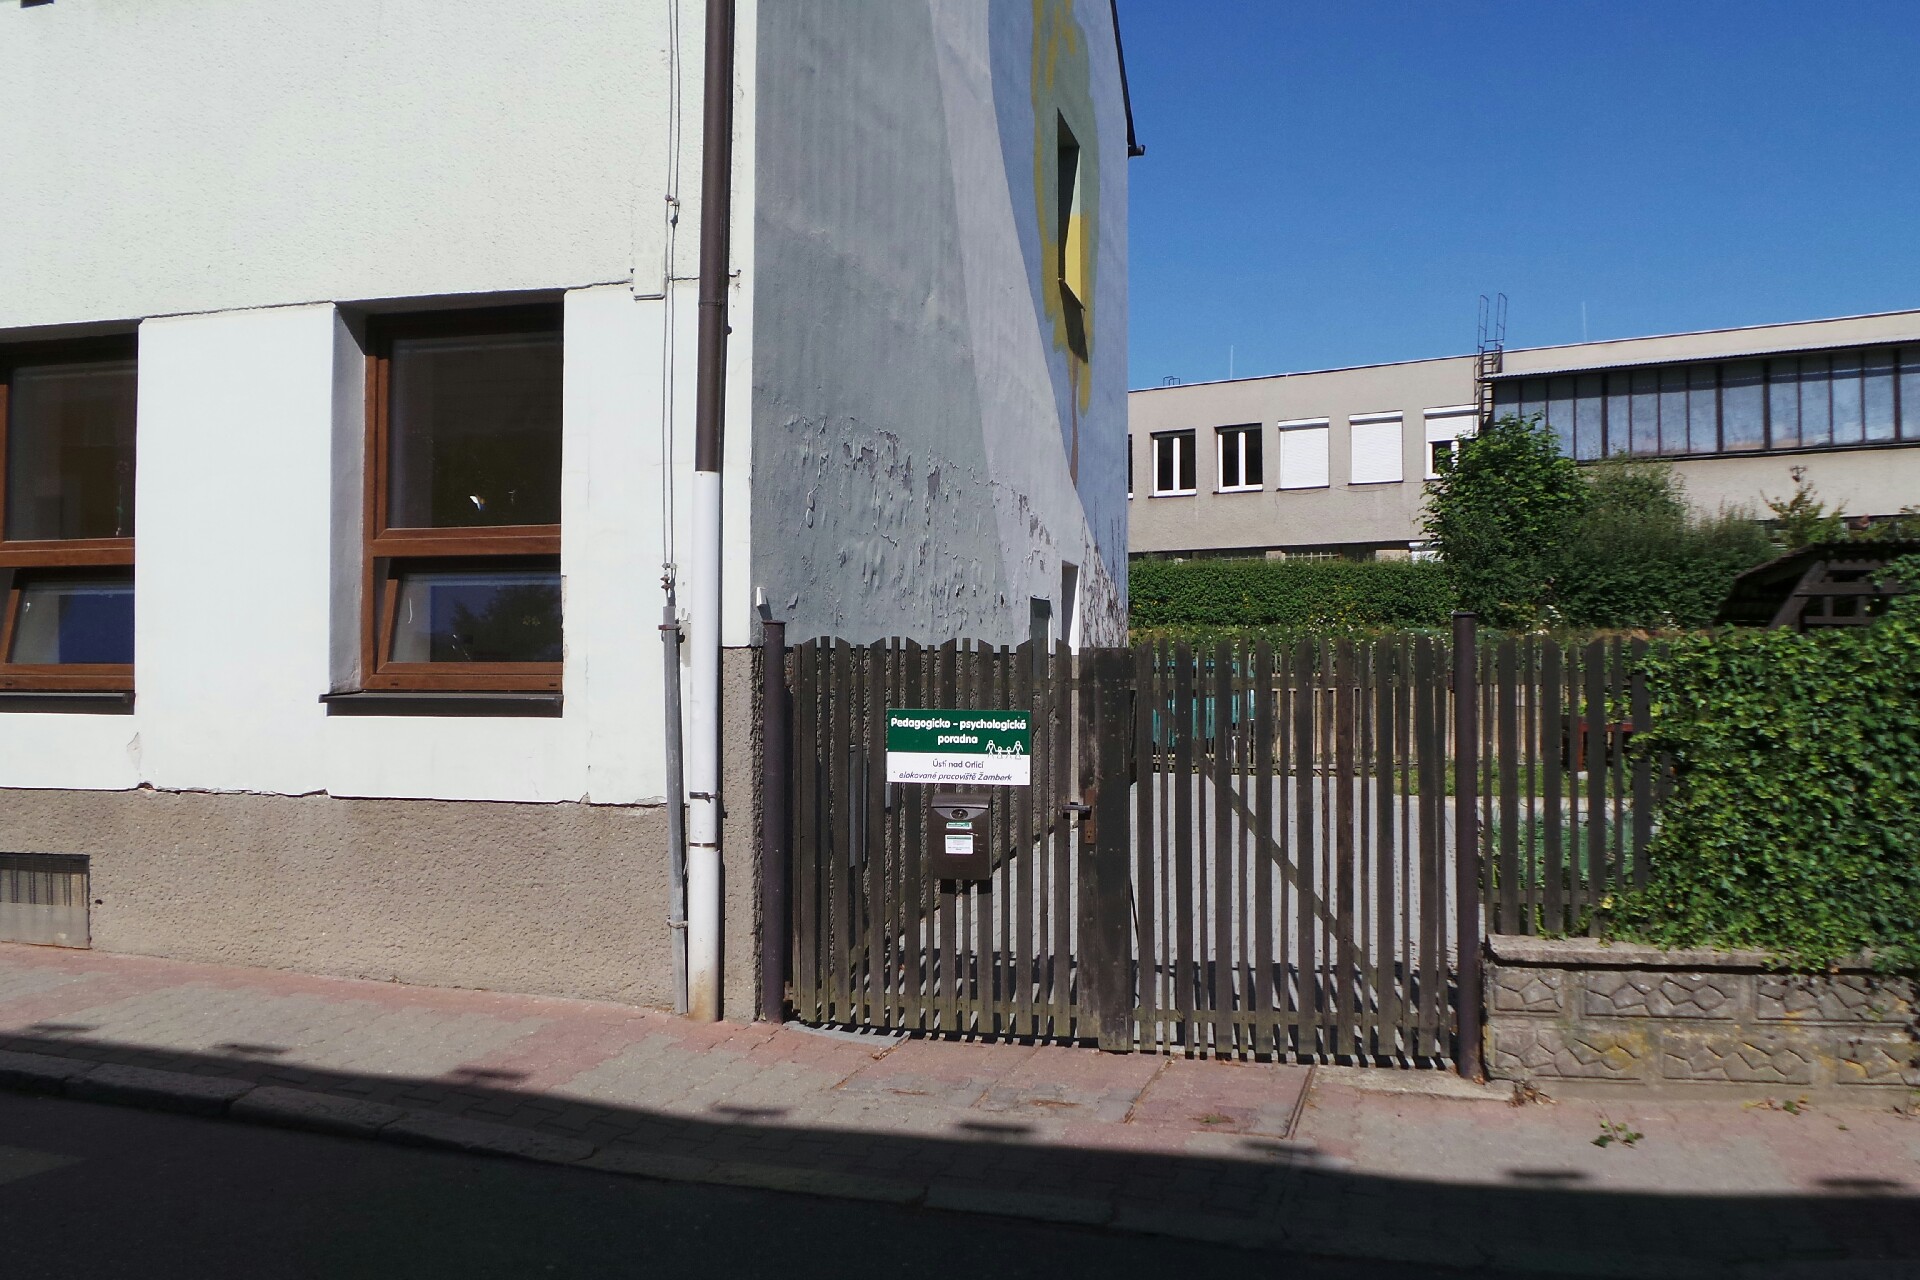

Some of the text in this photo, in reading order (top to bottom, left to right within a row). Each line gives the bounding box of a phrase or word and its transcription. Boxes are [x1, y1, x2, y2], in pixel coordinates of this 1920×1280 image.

[891, 717, 951, 730] Pedagogicko
[960, 719, 1027, 731] psychologická
[938, 734, 979, 745] poradna
[932, 758, 984, 769] Ústí nad Orlicí
[978, 771, 1013, 782] Žamberk
